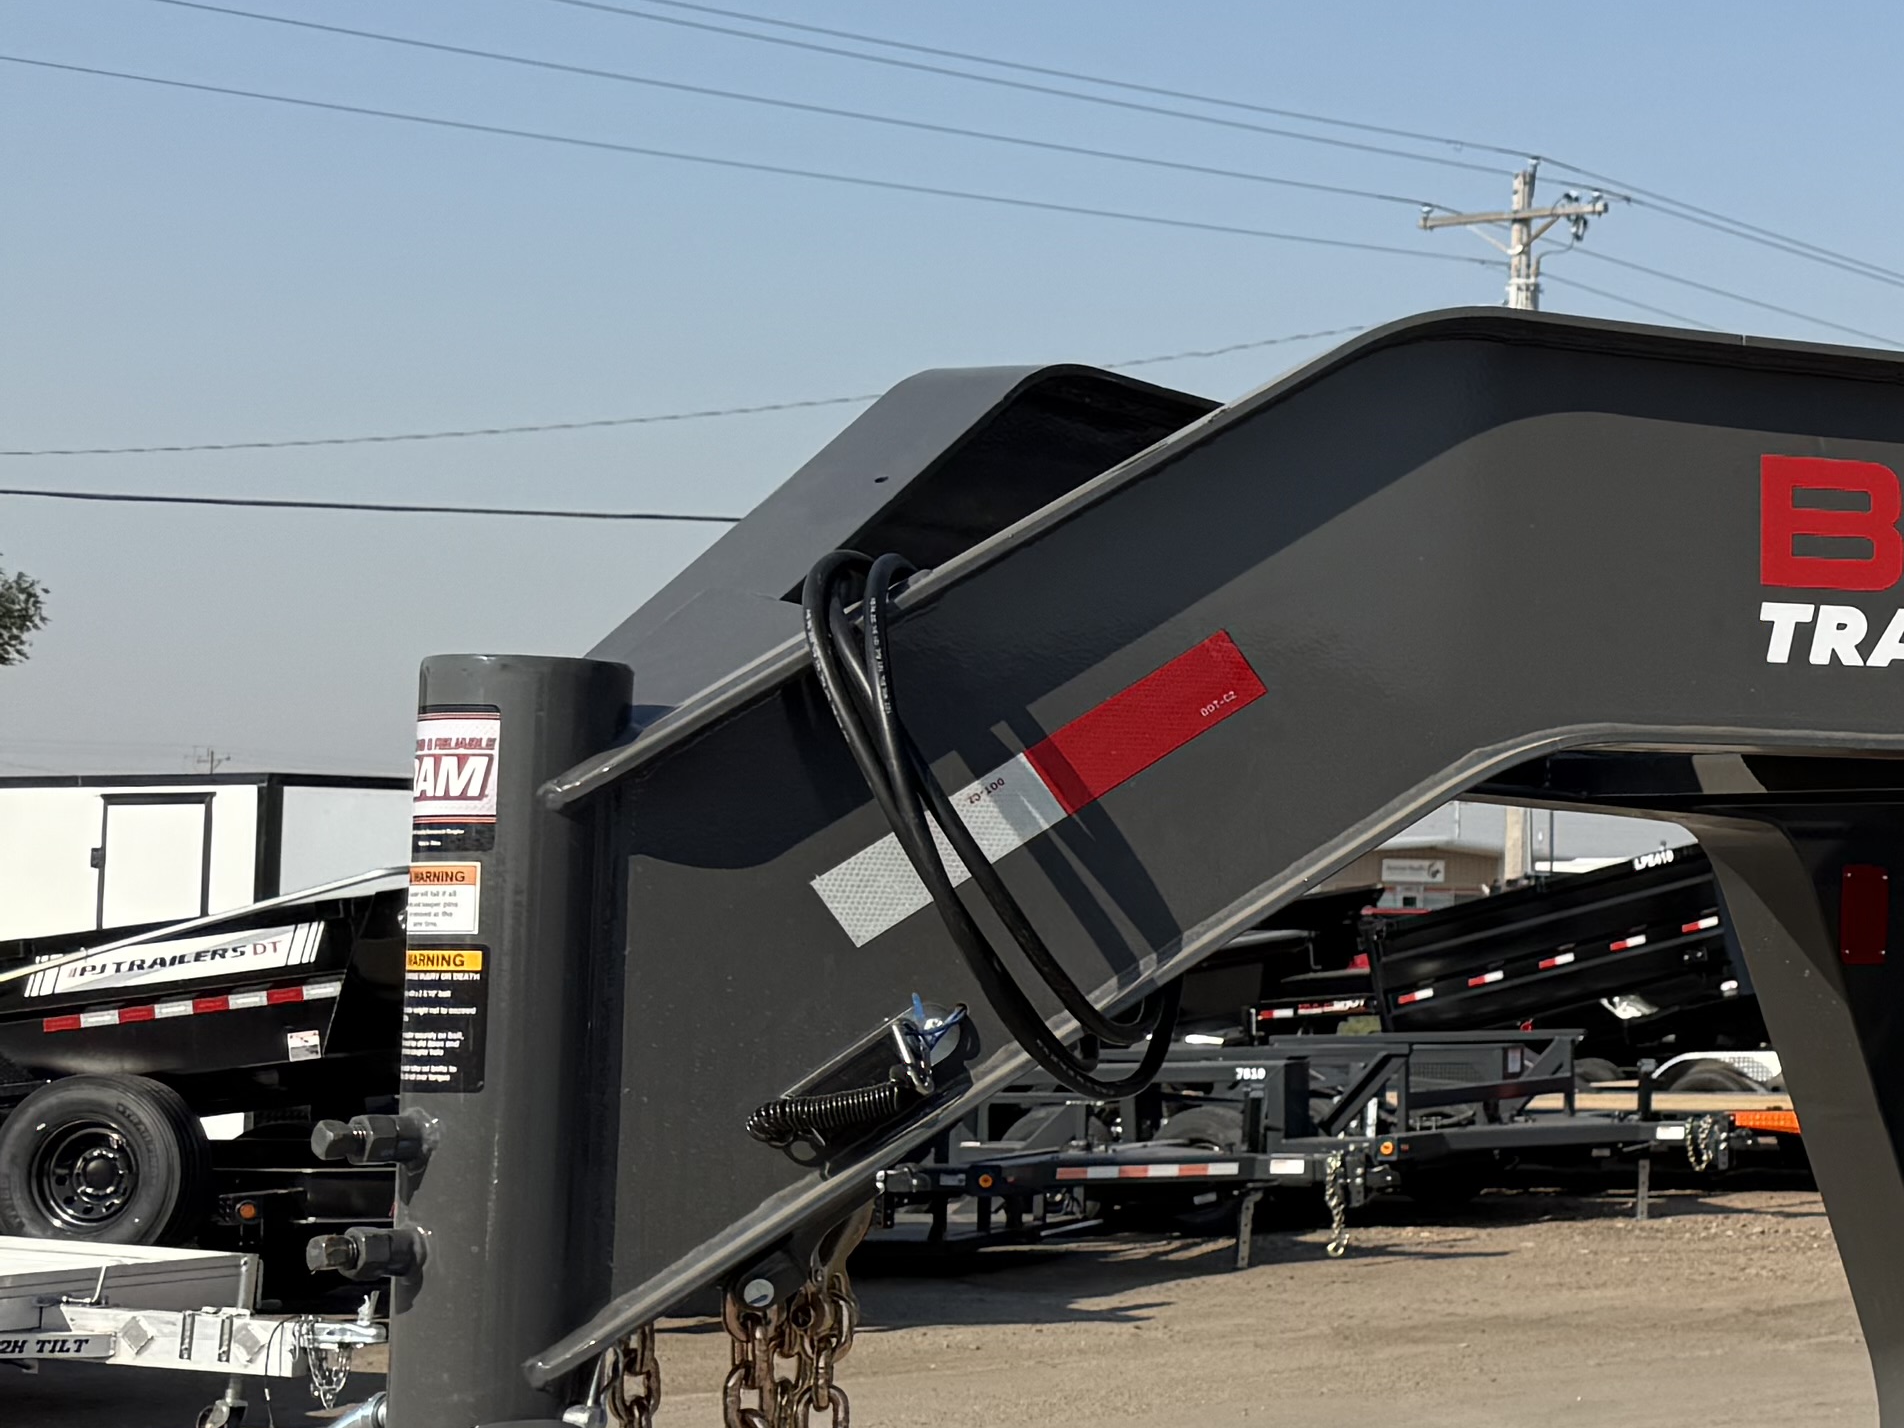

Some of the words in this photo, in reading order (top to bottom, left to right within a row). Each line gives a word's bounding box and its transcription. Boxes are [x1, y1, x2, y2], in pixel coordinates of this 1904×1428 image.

[79, 964, 107, 977] PJ
[111, 944, 247, 974] TRAILERS
[252, 940, 283, 956] DT
[36, 1338, 90, 1354] TILT
